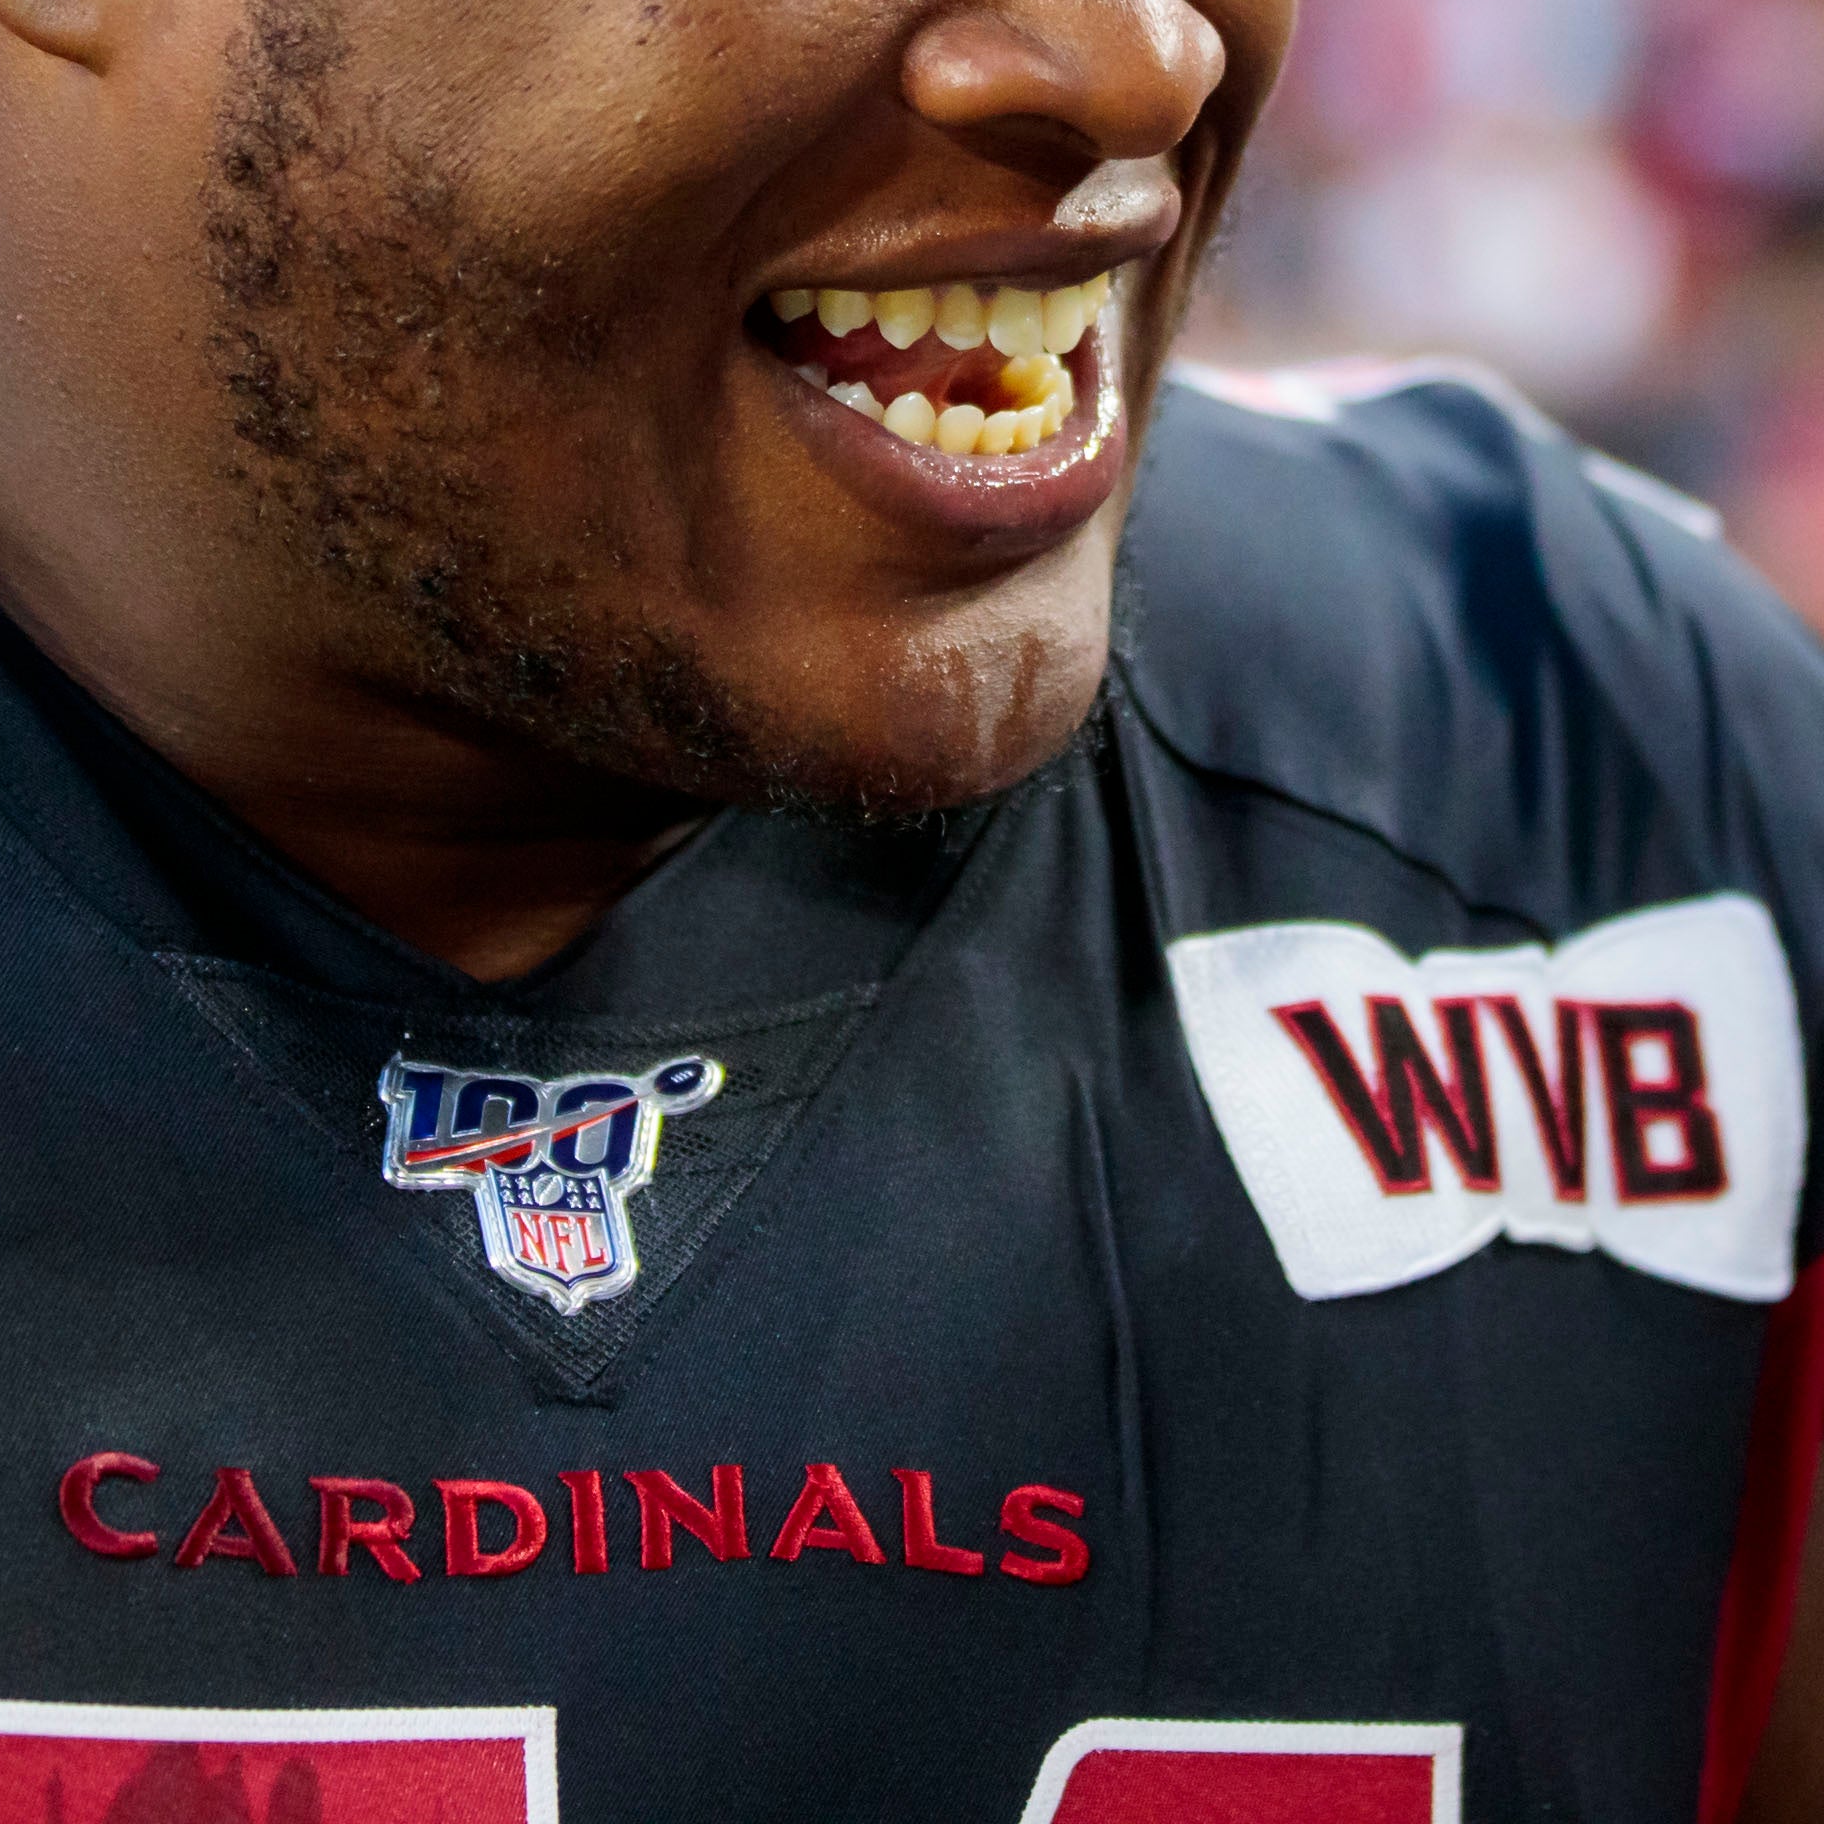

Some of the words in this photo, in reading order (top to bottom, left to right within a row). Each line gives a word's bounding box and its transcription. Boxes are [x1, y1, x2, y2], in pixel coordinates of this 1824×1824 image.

[398, 1069, 640, 1178] 100
[1269, 994, 1730, 1205] WVB
[511, 1211, 607, 1275] NFL
[57, 1450, 1093, 1587] CARDINALS
